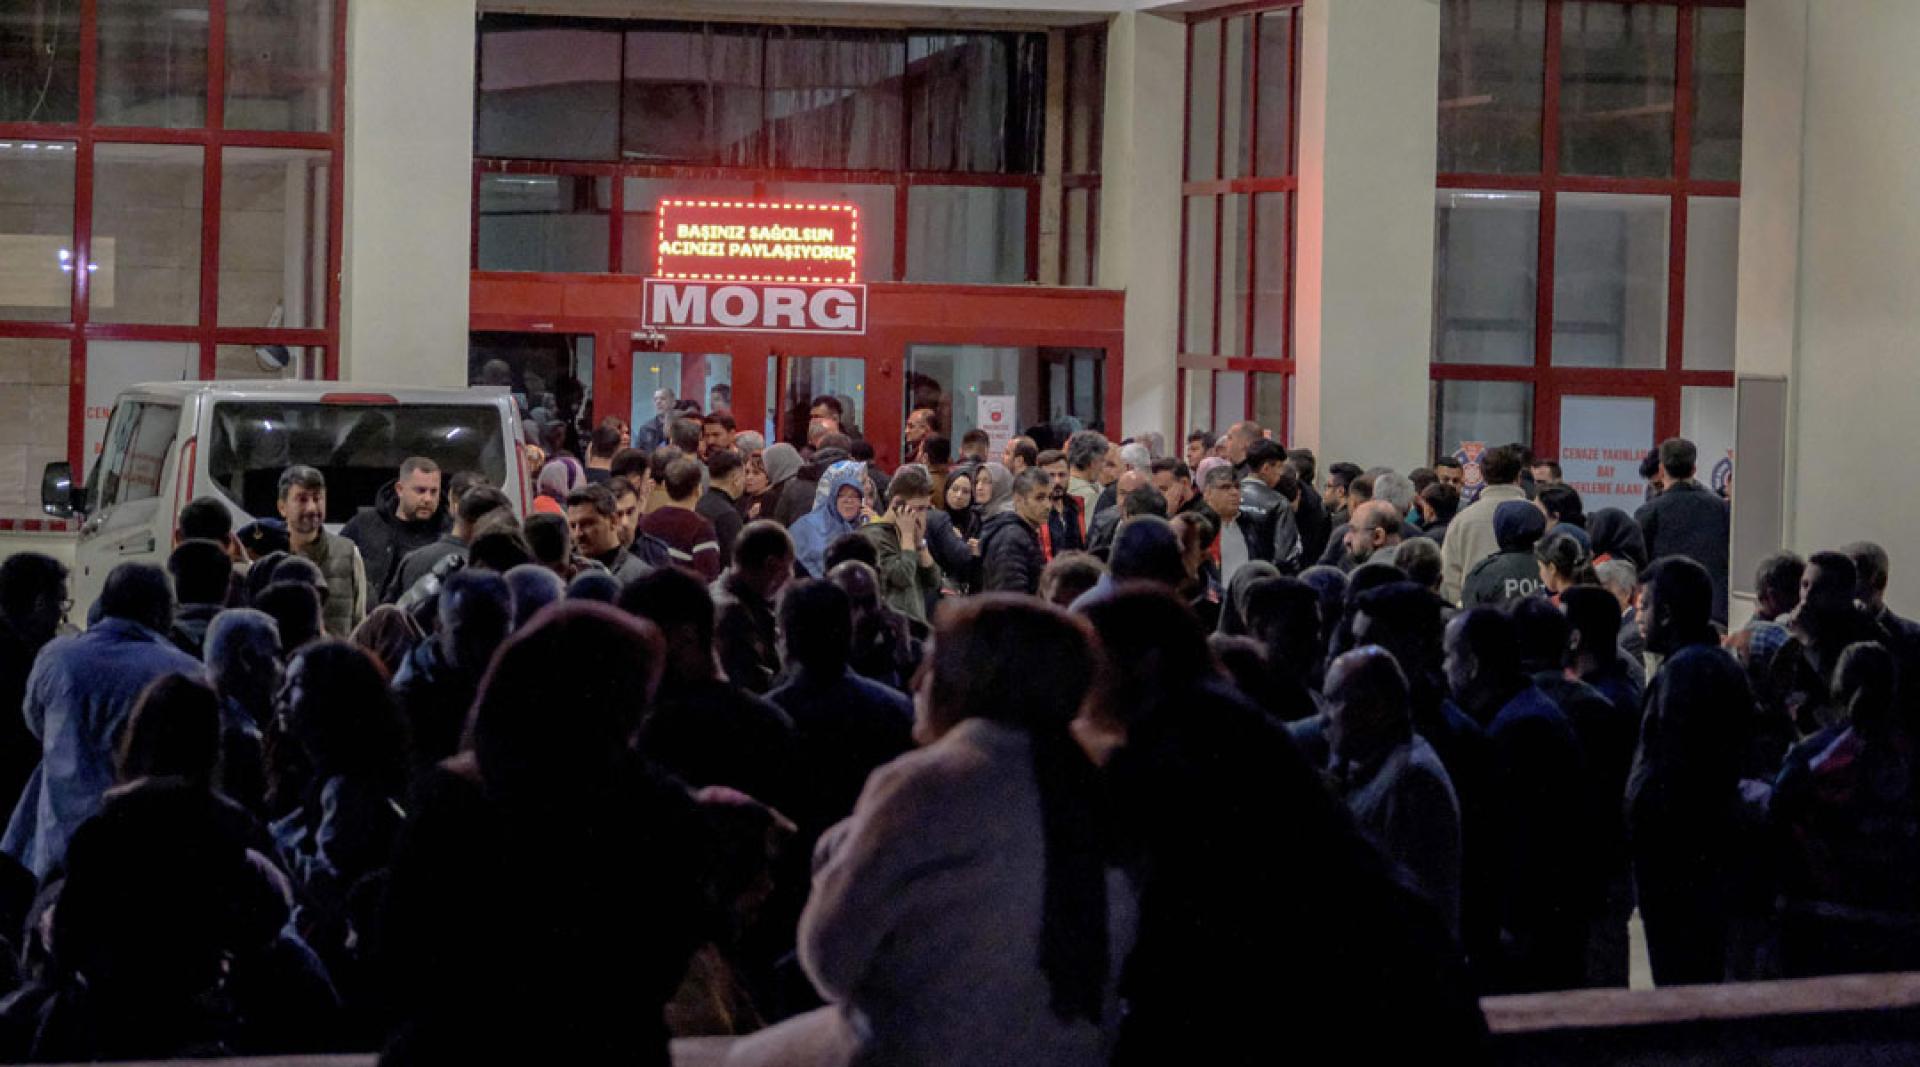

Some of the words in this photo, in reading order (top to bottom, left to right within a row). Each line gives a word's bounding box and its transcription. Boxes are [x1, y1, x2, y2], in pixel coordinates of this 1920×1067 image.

[676, 224, 745, 241] BAŞINIZ
[749, 223, 834, 242] SAĞOLSUN
[659, 241, 725, 257] ACINIZI
[728, 243, 856, 261] PAYLAŞIYORUZ
[652, 283, 857, 329] MORG
[86, 406, 111, 418] CEN
[1562, 447, 1599, 460] CENAZE
[1596, 464, 1616, 477] BAY
